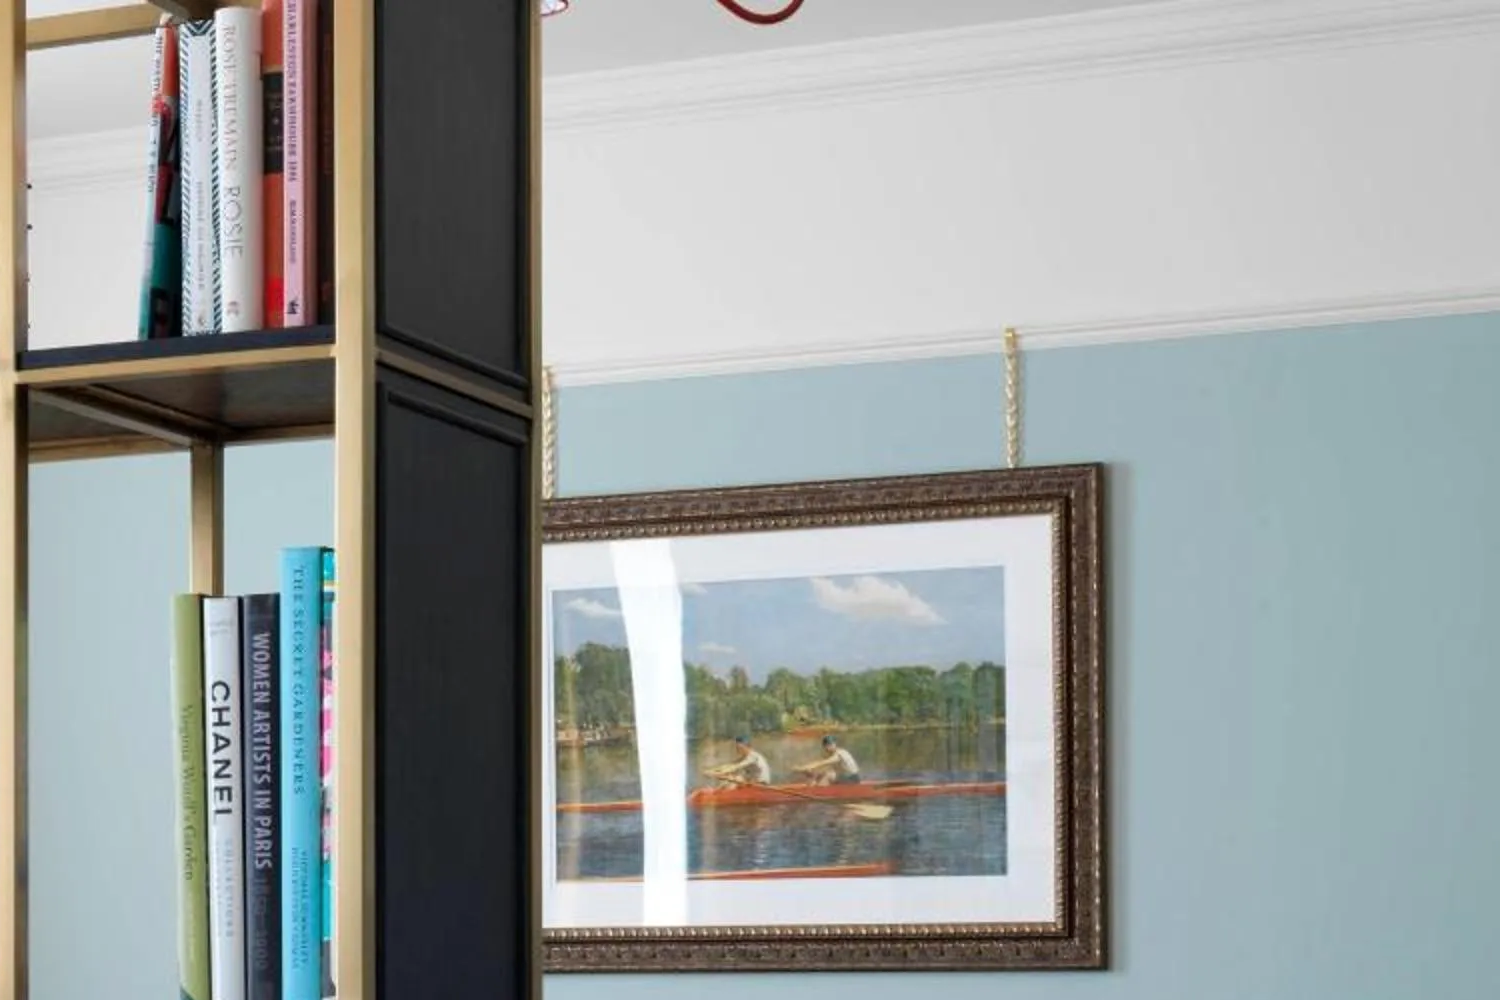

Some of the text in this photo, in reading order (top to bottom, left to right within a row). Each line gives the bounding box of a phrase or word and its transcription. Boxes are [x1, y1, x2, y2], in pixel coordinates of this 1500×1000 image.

[223, 186, 244, 259] ROSIE
[252, 632, 272, 703] WOMEN
[292, 566, 306, 796] THE SECRET GARDENERS
[181, 704, 195, 762] Virginia
[210, 679, 234, 822] CHANEL
[252, 709, 273, 784] ARTISTS
[253, 789, 273, 809] IN
[182, 825, 197, 882] Garden
[254, 814, 274, 870] PARIS
